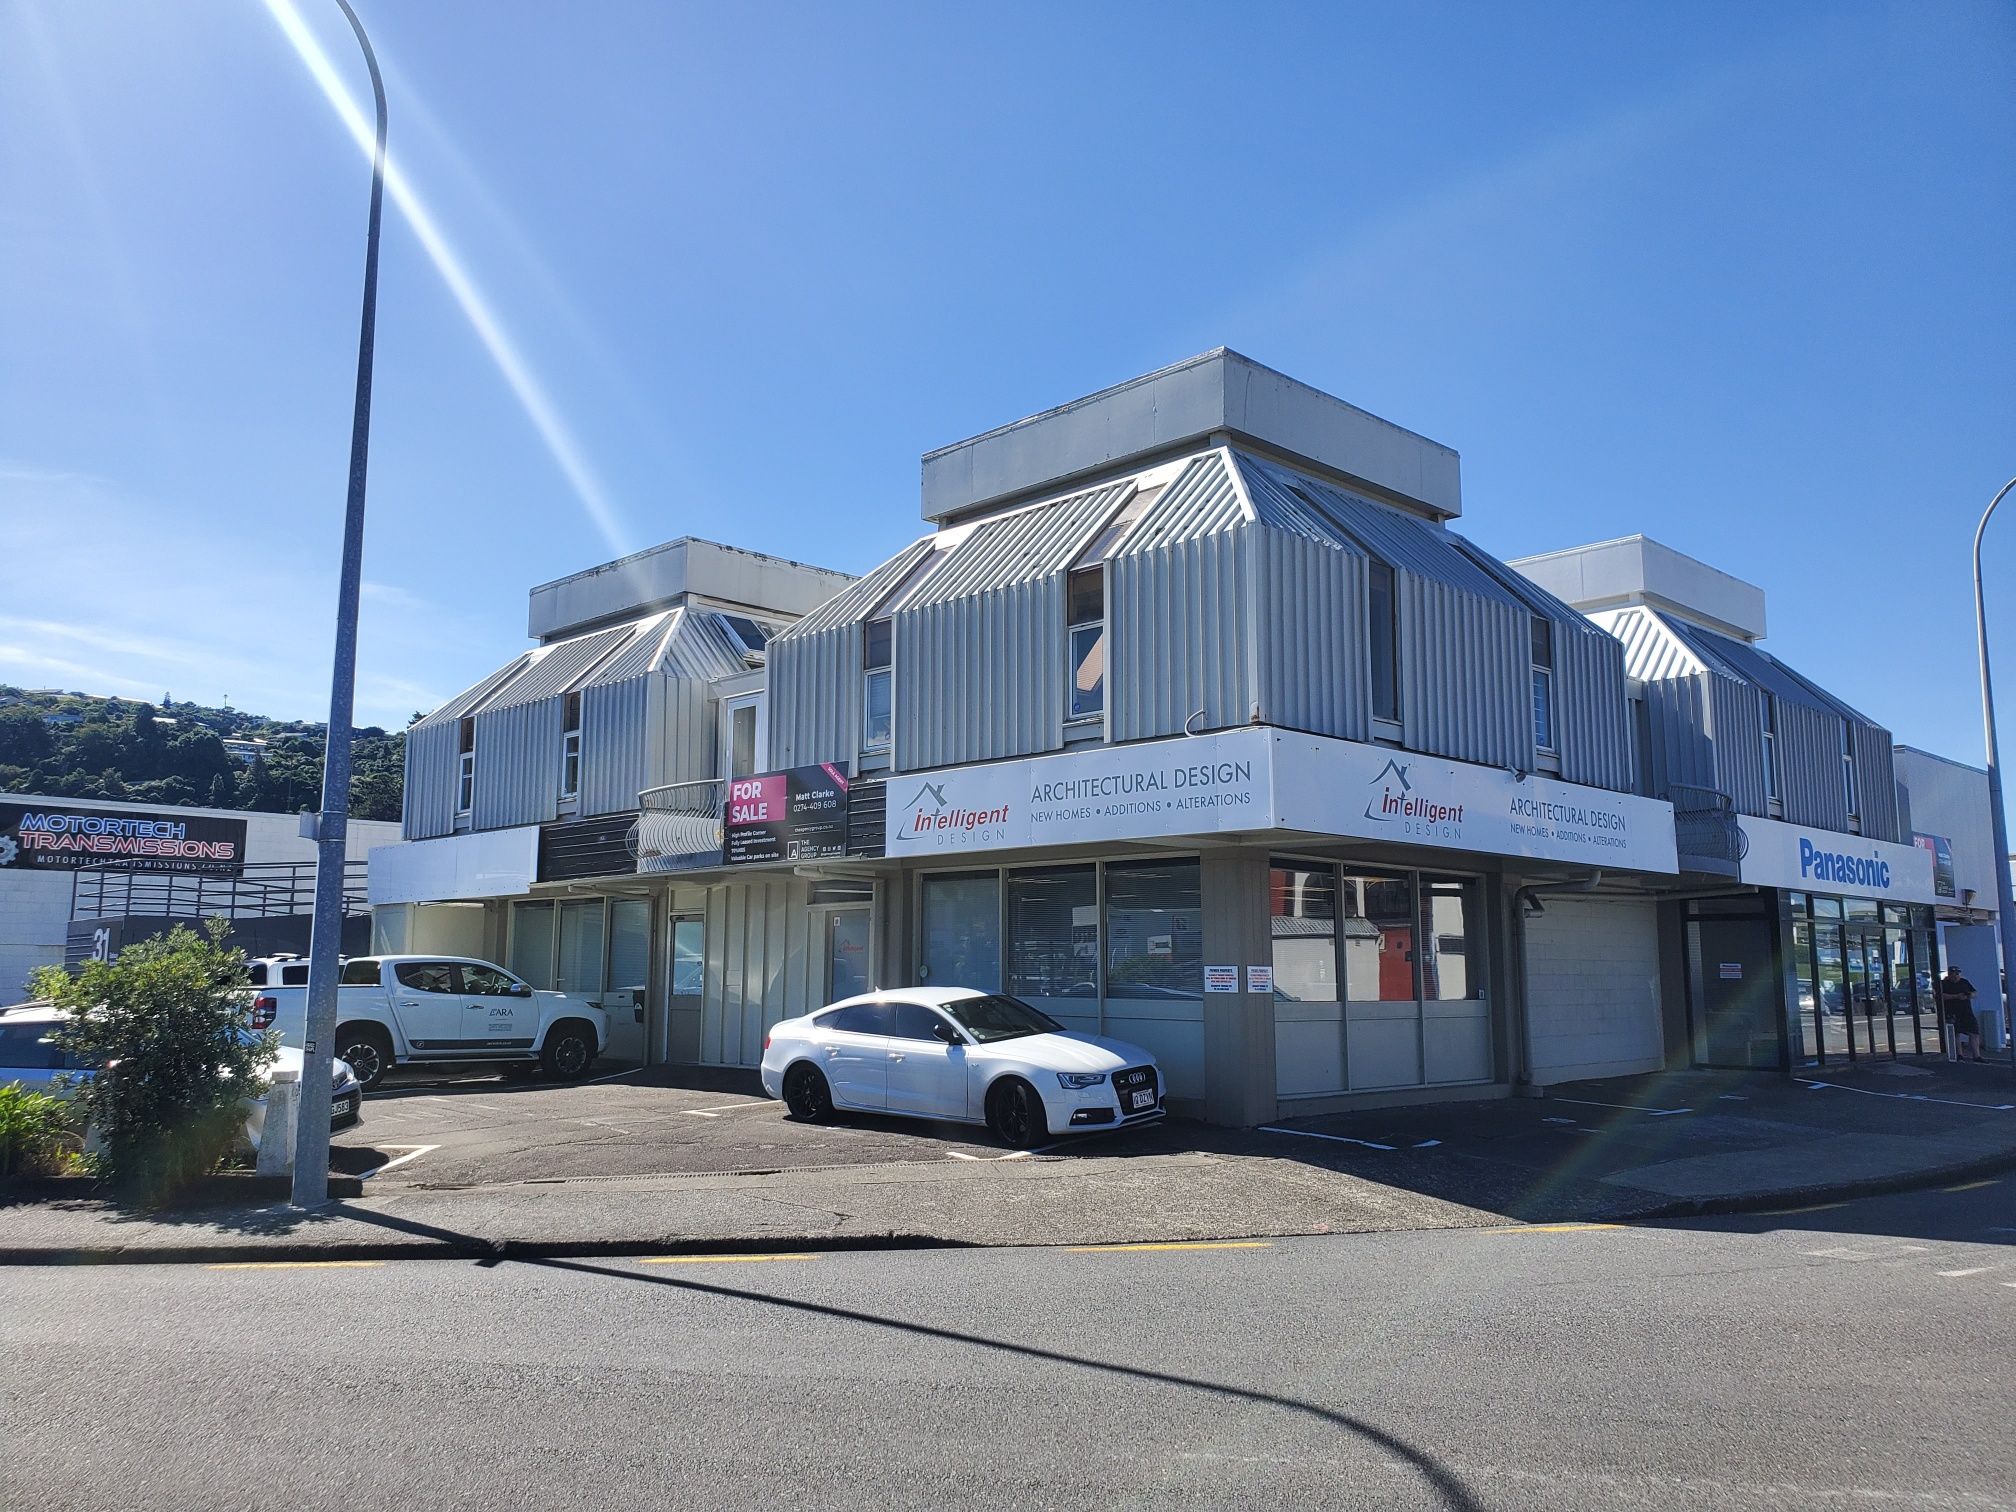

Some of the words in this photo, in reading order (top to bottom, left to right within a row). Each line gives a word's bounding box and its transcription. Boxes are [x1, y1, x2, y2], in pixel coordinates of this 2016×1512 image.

[733, 781, 762, 801] FOR
[795, 792, 810, 801] Matt
[811, 789, 835, 799] Clarke
[1031, 770, 1168, 803] ARCHITECTURAL
[1174, 760, 1251, 789] DESIGN
[732, 803, 768, 822] SALE
[914, 804, 1009, 832] intelligent
[1031, 812, 1052, 823] NEW
[1056, 807, 1091, 821] HOMES
[1104, 800, 1161, 816] ADDITIONS
[1176, 792, 1251, 810] ALTERATIONS
[1382, 787, 1464, 823] intelligent
[1509, 797, 1589, 826] ARCHITECTURAL
[1591, 810, 1626, 831] DESIGN
[19, 813, 186, 839] MOTORTECH
[937, 828, 1006, 846] DESIGN
[1405, 821, 1461, 839] DESIGN
[1510, 823, 1525, 834] NEW
[1527, 826, 1549, 838] HOMES
[1556, 831, 1586, 843] ADDITIONS
[1592, 835, 1627, 848] ALTERATIONS
[19, 831, 235, 860] TRANSMISSIONS
[801, 845, 820, 853] AGENCY
[1799, 837, 1890, 889] Panasonic
[92, 927, 111, 964] 31
